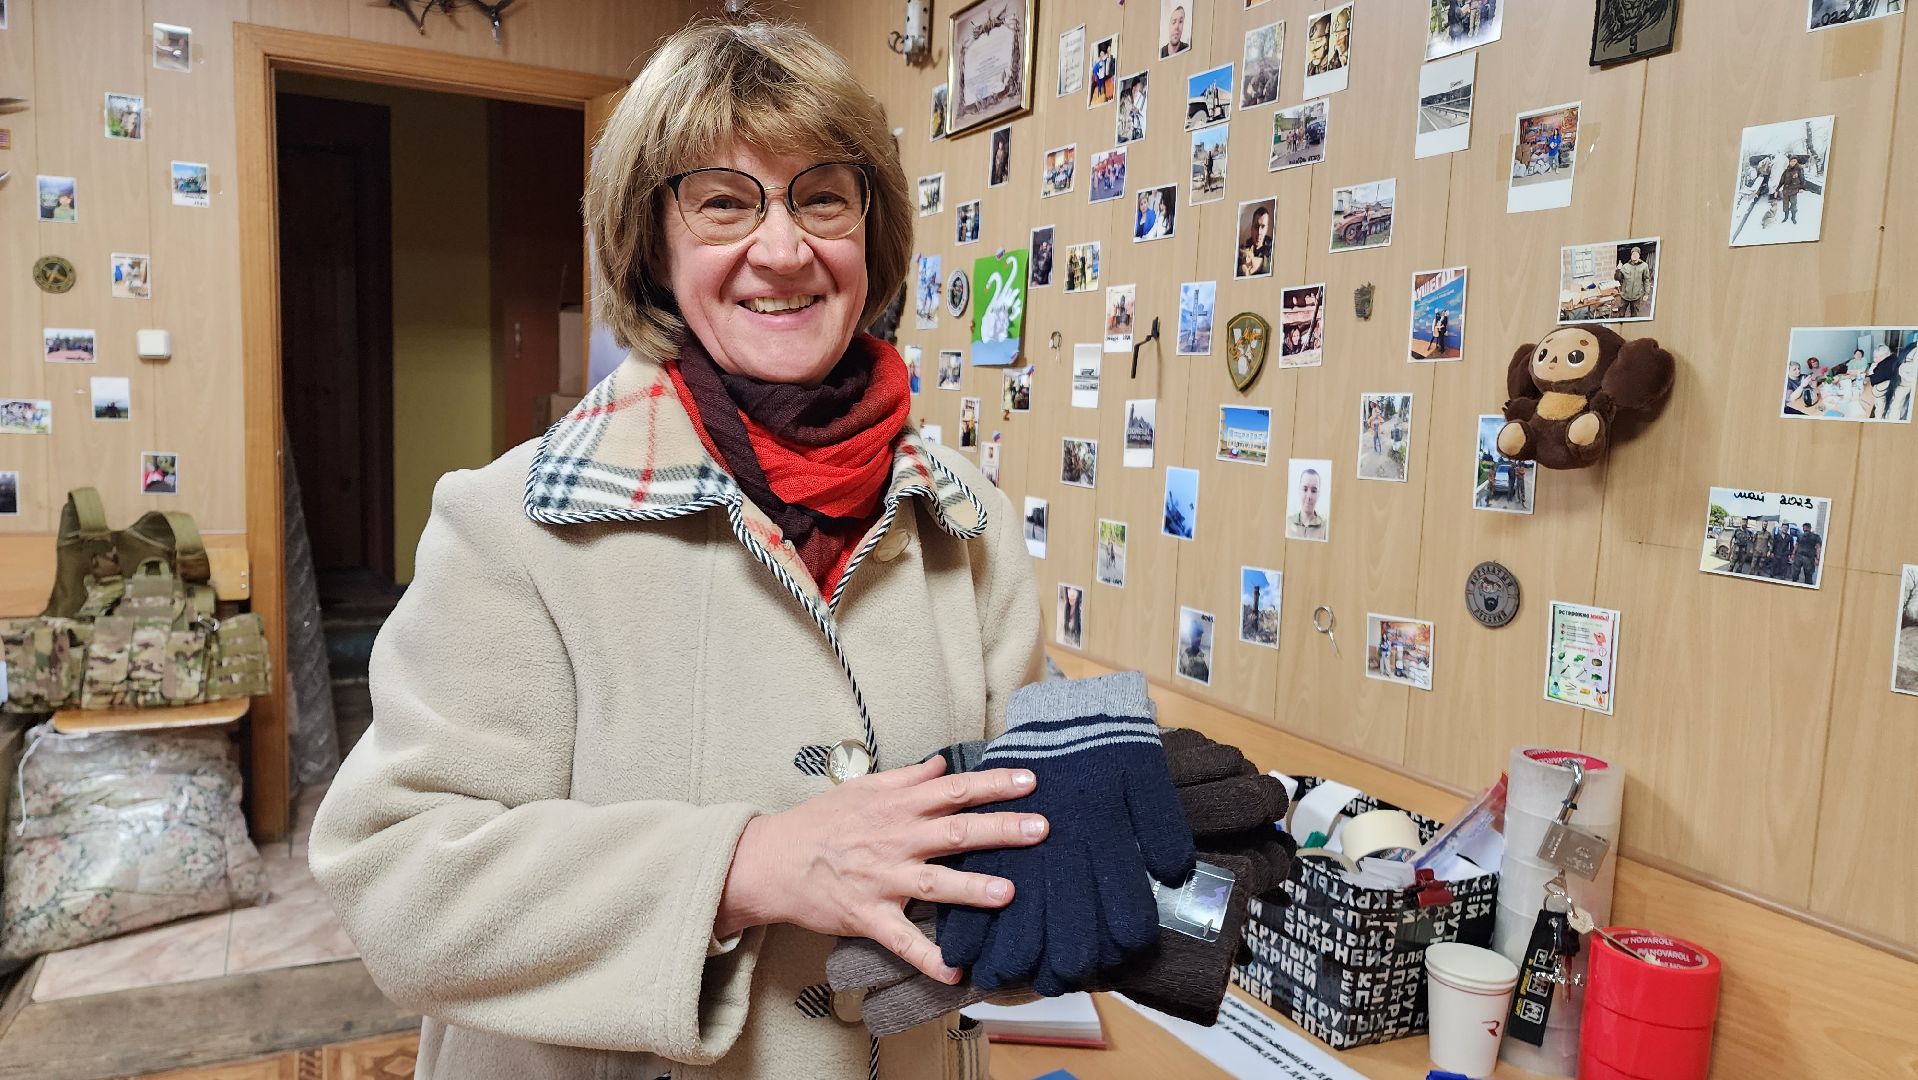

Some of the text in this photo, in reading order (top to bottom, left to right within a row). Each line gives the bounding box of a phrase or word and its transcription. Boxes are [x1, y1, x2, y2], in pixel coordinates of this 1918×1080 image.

[1780, 494, 1813, 509] 2023
[1630, 936, 1674, 947] NOVAROLL
[1649, 948, 1691, 963] NOVAROLL
